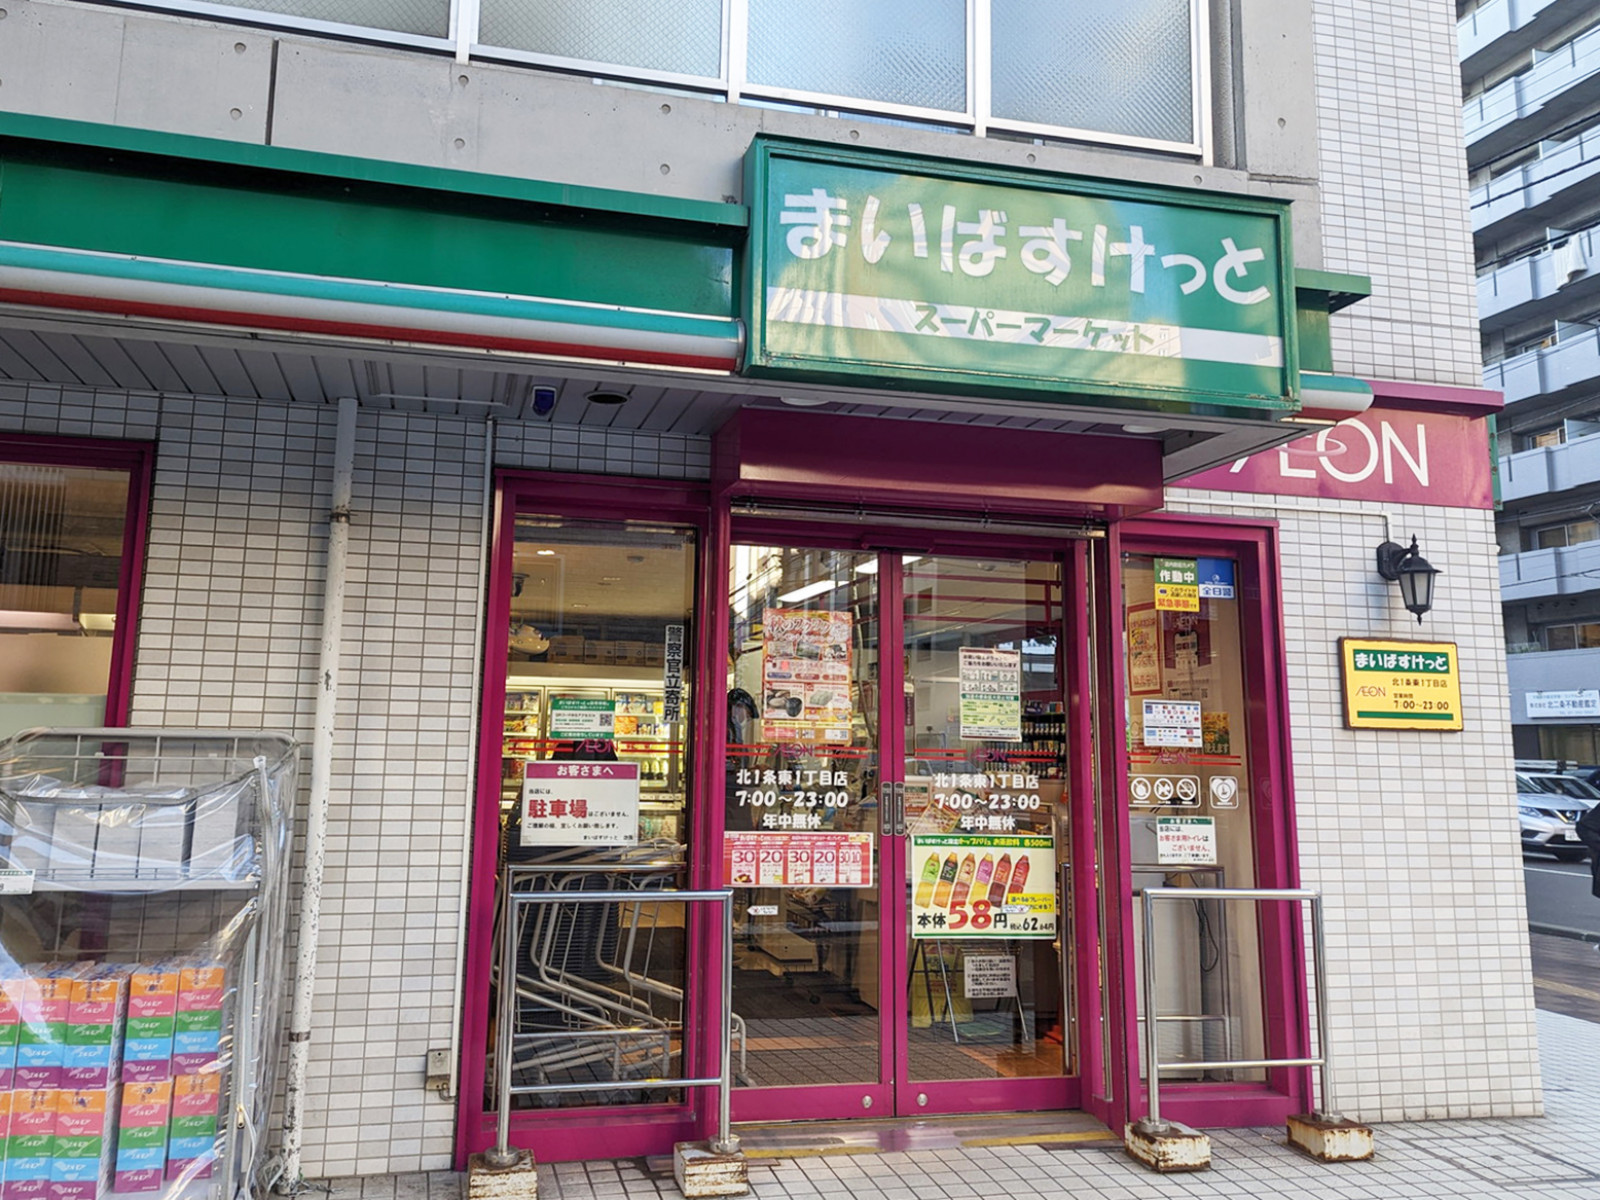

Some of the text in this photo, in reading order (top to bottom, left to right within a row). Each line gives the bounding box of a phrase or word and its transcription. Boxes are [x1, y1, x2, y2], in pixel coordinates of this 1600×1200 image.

[780, 187, 1271, 305] まいばすけっと
[914, 304, 1154, 352] スーパーマーケット
[1159, 569, 1195, 583] 作動中
[1354, 652, 1448, 671] まいばすけっと
[664, 626, 683, 722] 警察官立寄所
[556, 765, 614, 777] お客さまへ
[736, 769, 848, 787] 北1条東1丁目店
[934, 772, 1040, 790] 北1条東1丁目店
[762, 813, 823, 830] 年中無休
[960, 814, 1016, 831] 年中無休
[733, 850, 756, 864] 30
[760, 850, 783, 864] 20
[789, 850, 811, 864] 30
[814, 850, 836, 864] 20
